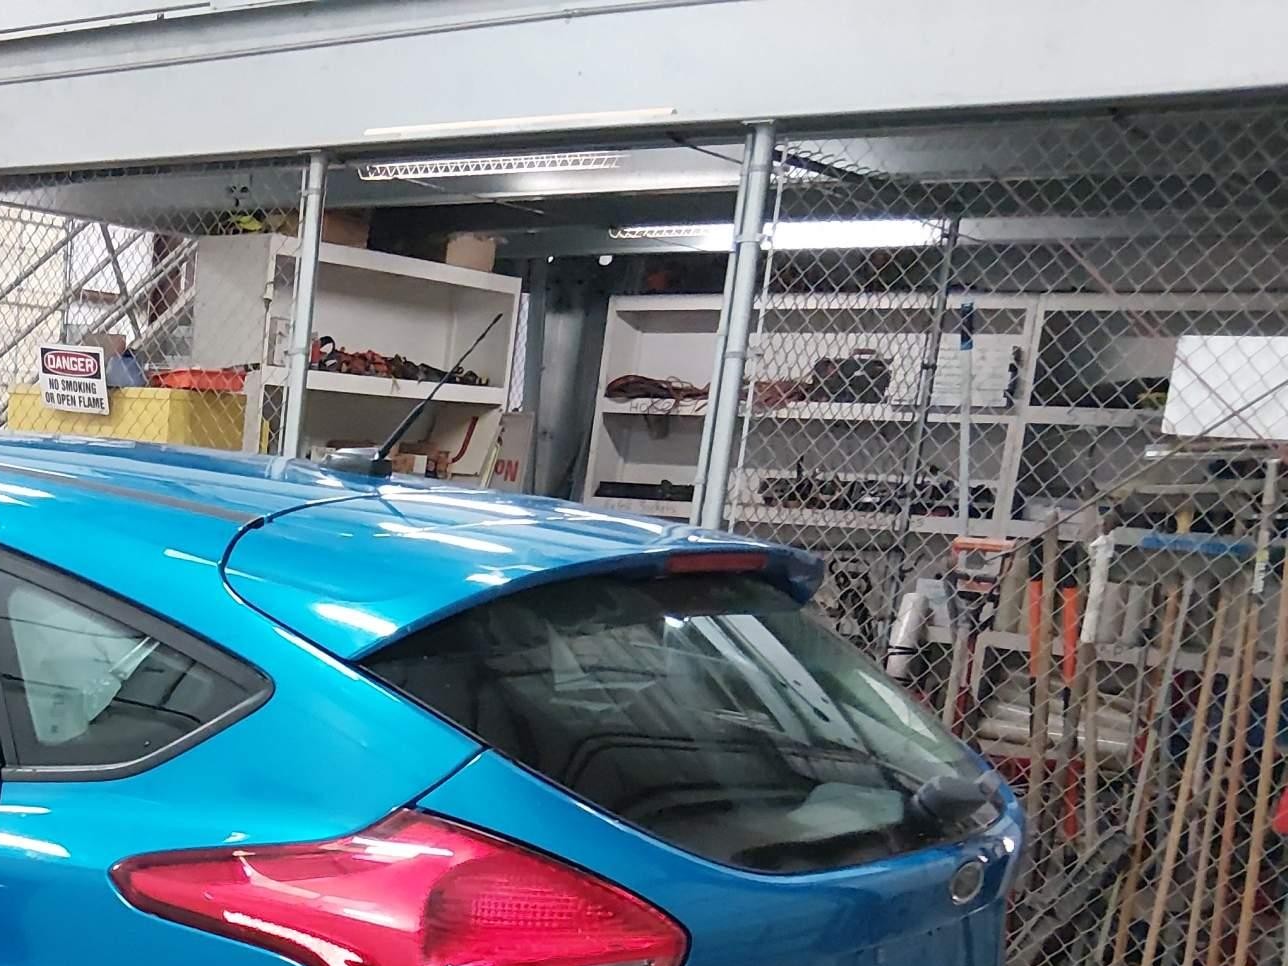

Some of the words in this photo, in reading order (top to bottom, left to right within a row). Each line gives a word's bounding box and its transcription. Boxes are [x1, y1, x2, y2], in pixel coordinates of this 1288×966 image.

[47, 354, 94, 372] DANGER
[49, 377, 59, 390] NO
[61, 379, 97, 394] SMOKING
[45, 392, 55, 404] OR
[57, 393, 76, 406] OPEN
[79, 396, 105, 410] FLAME
